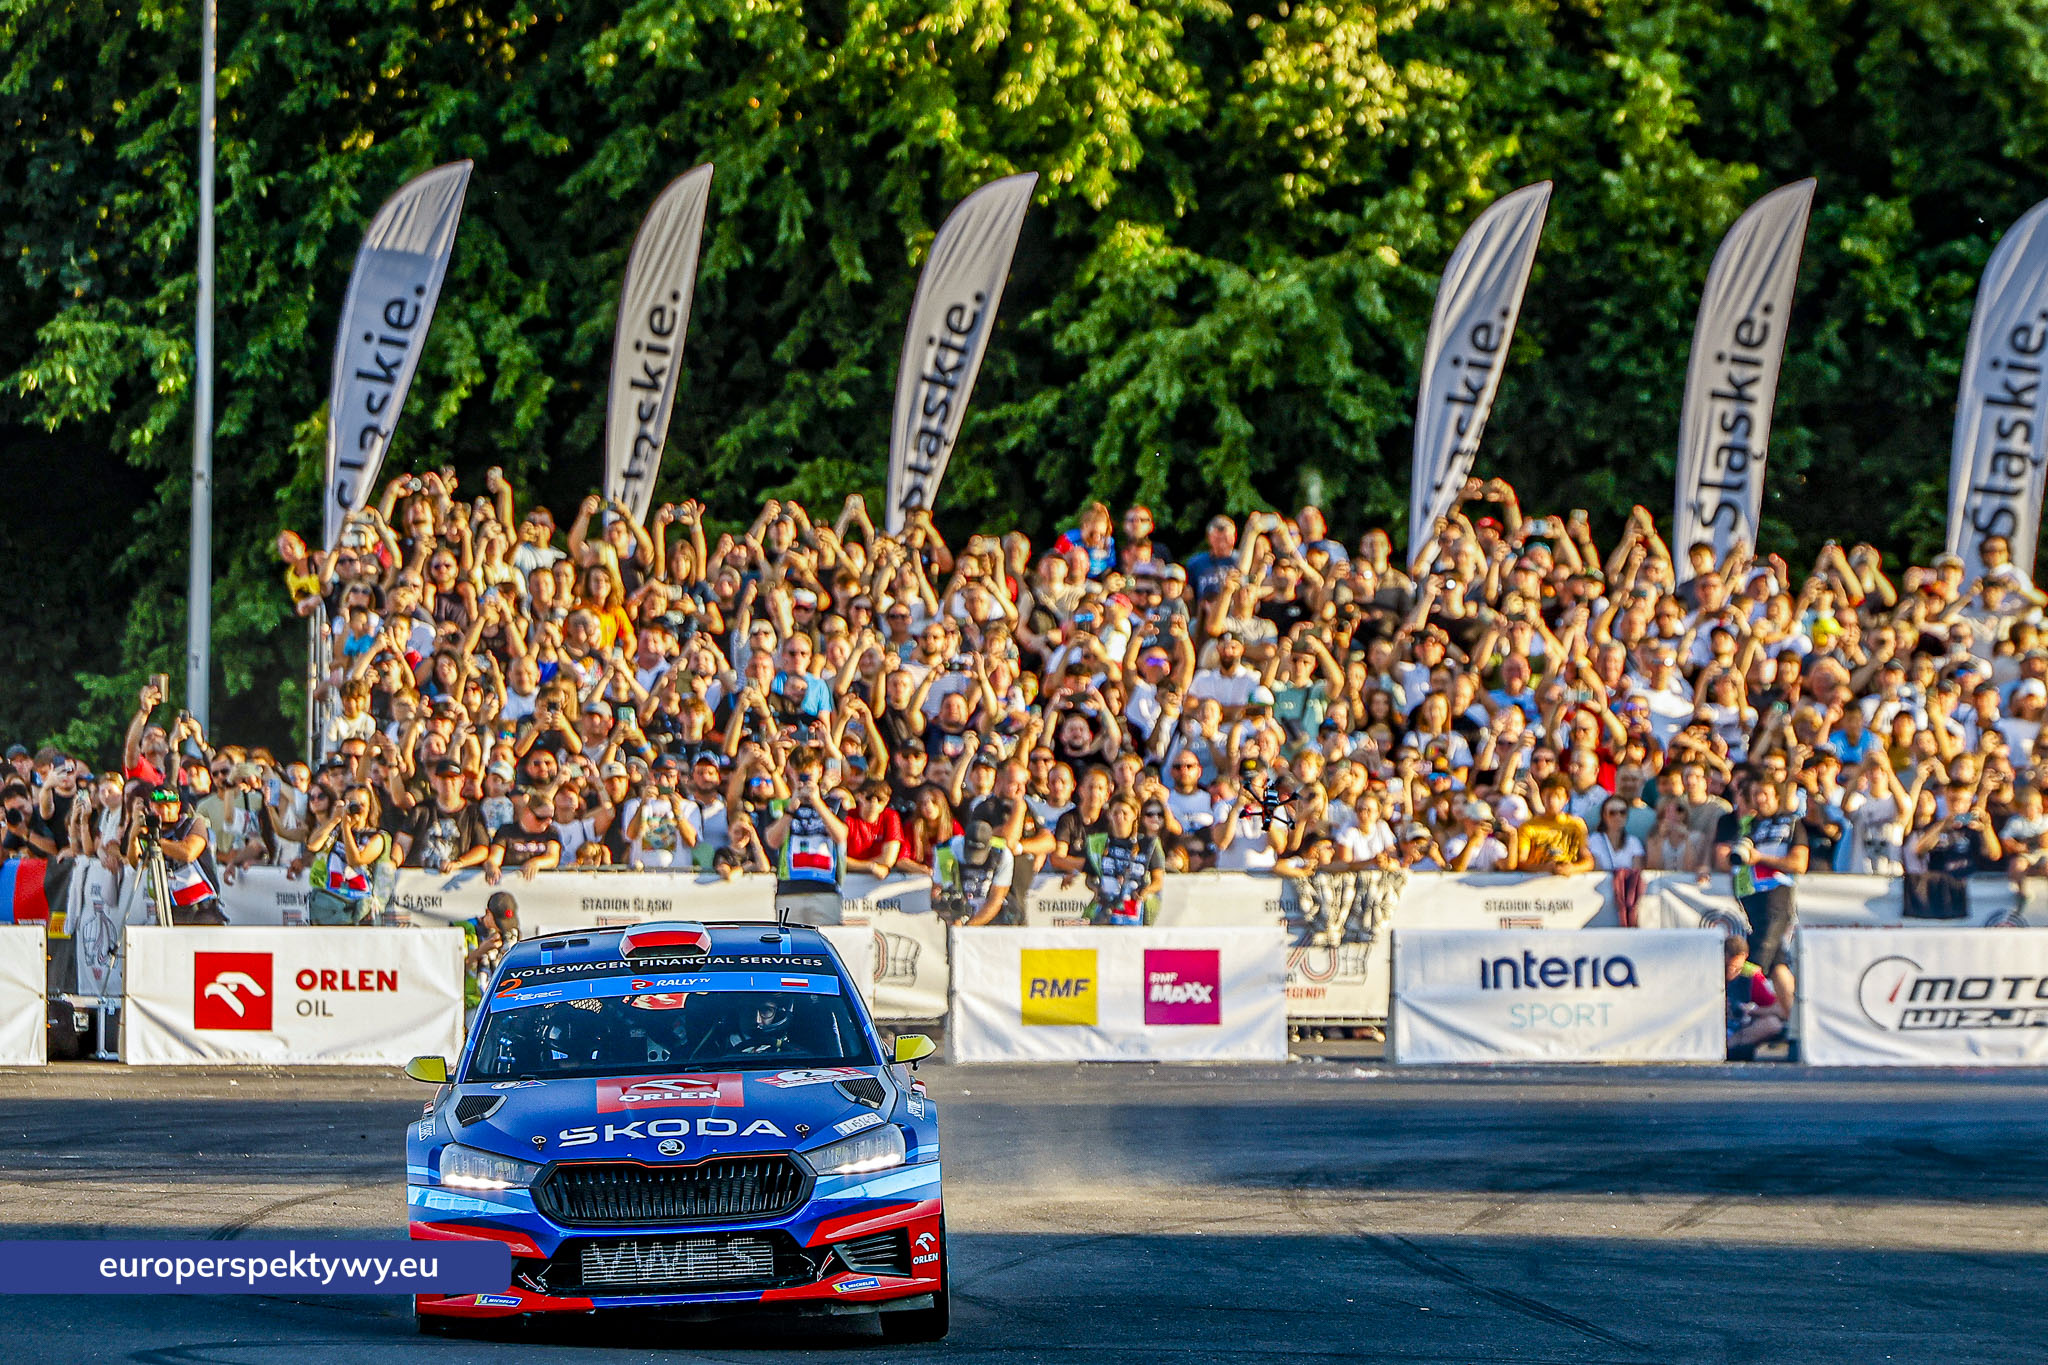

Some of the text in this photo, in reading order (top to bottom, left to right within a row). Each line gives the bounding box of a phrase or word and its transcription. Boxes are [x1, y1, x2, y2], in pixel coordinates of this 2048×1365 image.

[582, 897, 631, 912] STADION
[510, 956, 823, 979] VOLKSWAGEN FINANCIAL SERVICES
[1480, 950, 1640, 990] interia
[295, 968, 399, 993] ORLEN
[496, 978, 522, 999] 2
[656, 978, 699, 987] RALLY
[1029, 978, 1091, 999] RMF
[296, 999, 334, 1017] OIL
[1510, 1002, 1614, 1030] SPORT
[617, 1089, 722, 1104] ORLEN
[912, 1252, 939, 1265] ORLEN
